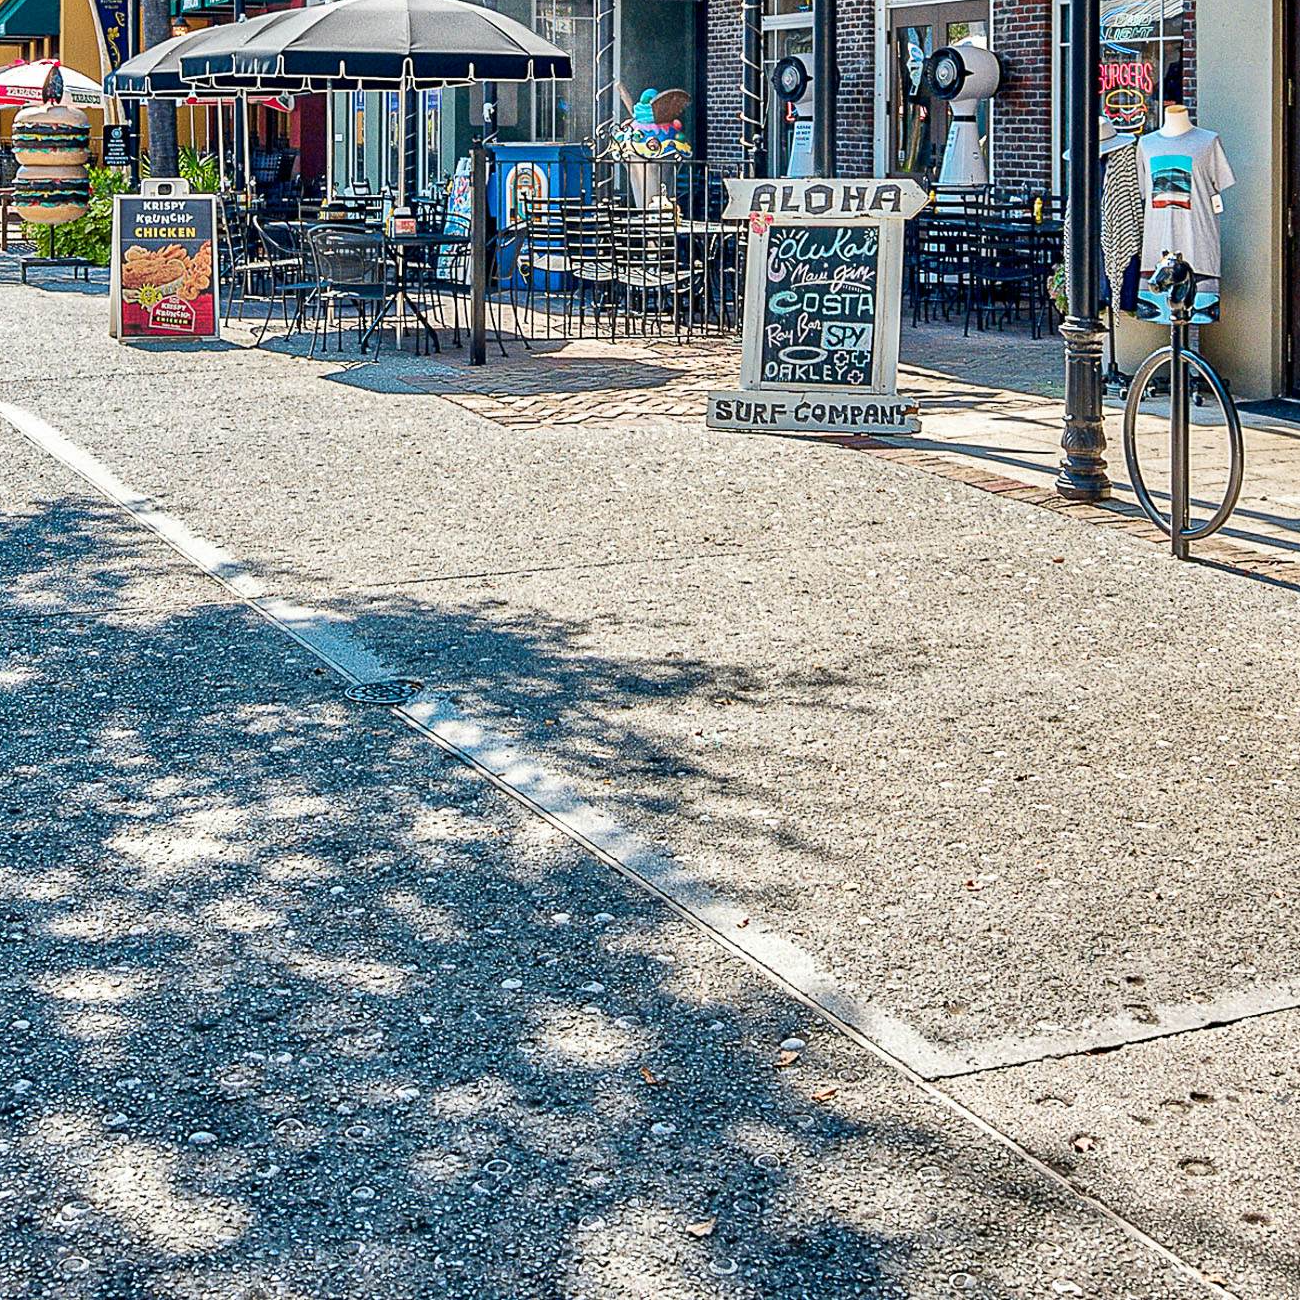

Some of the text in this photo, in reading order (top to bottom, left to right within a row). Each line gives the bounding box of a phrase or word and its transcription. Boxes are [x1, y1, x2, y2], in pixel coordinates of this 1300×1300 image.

[1105, 26, 1154, 40] LIGHT
[7, 89, 43, 99] TABASC
[143, 201, 186, 211] KRISPY
[750, 183, 901, 215] ALOHA
[135, 213, 194, 225] KRUNCHY
[135, 227, 197, 238] CHICKEN
[791, 262, 829, 283] Maui
[769, 290, 874, 316] COSTA
[766, 323, 794, 348] Ray
[827, 324, 867, 348] SPY
[765, 360, 850, 382] OAKLEY
[715, 399, 910, 426] SURF COMPANY
